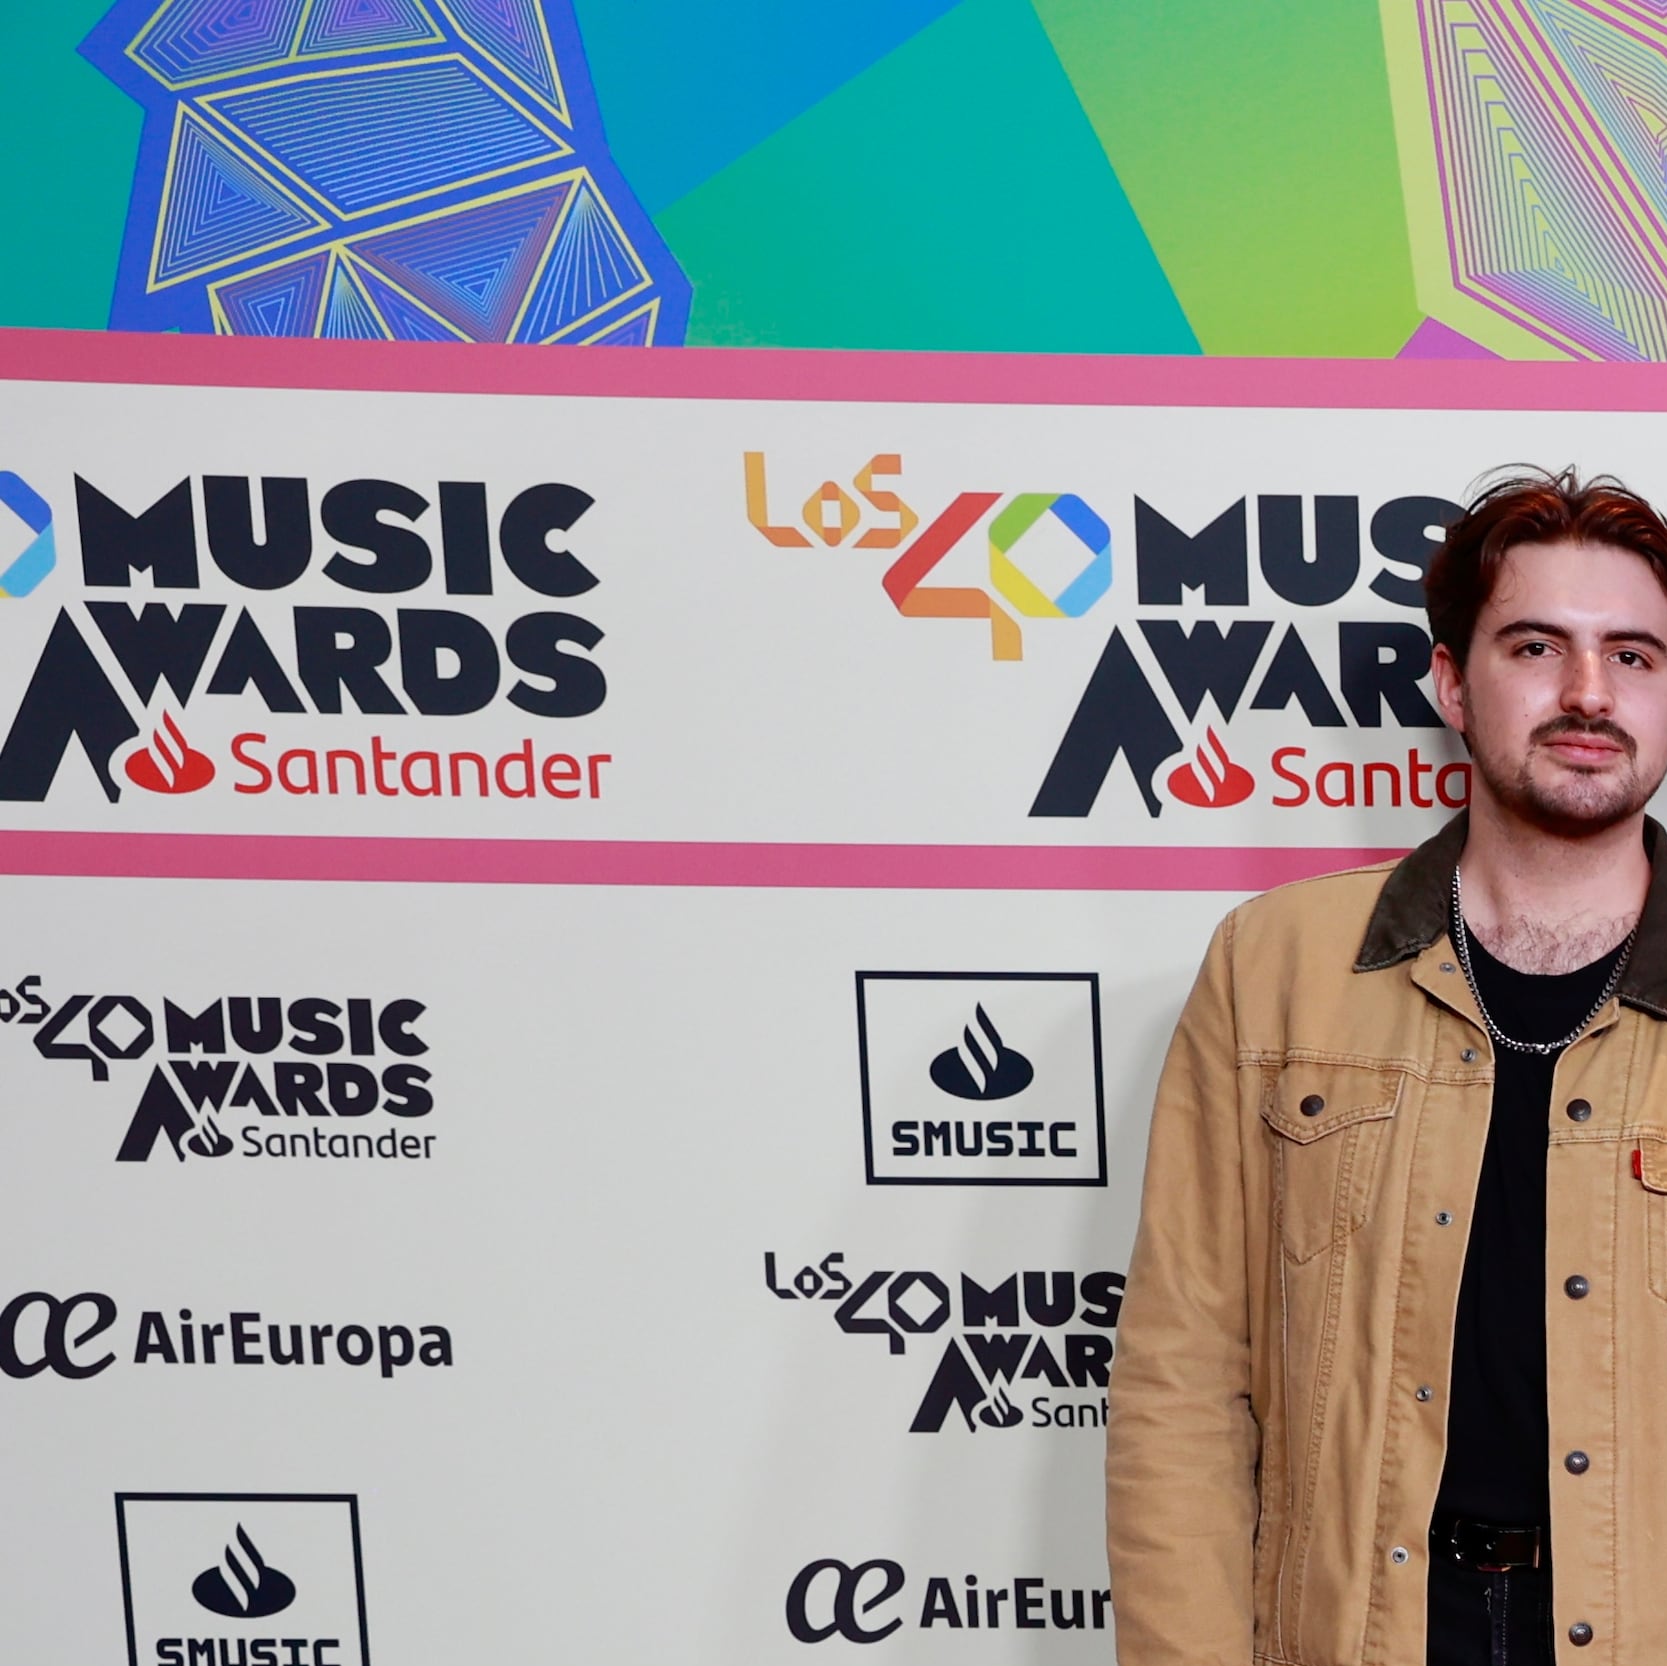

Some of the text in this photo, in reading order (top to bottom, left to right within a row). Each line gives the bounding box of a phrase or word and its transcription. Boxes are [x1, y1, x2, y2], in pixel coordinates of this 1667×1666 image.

[74, 472, 600, 597] MUSIC
[882, 492, 1112, 661] 40
[1134, 494, 1468, 607] MUS
[0, 601, 607, 803] AWARDS
[1028, 619, 1446, 818] AWAR
[230, 732, 612, 799] Santander
[1271, 746, 1472, 808] Santa
[33, 994, 154, 1081] 40
[163, 996, 430, 1057] MUSIC
[115, 1060, 434, 1162] AWARDS
[242, 1126, 437, 1159] Santander
[892, 1121, 1077, 1157] SMUSIC
[134, 1308, 454, 1378] AirEuropa
[834, 1271, 951, 1355] 40
[960, 1271, 1127, 1328] MUS
[909, 1334, 1114, 1433] AWAR
[920, 1575, 1111, 1630] AirEur
